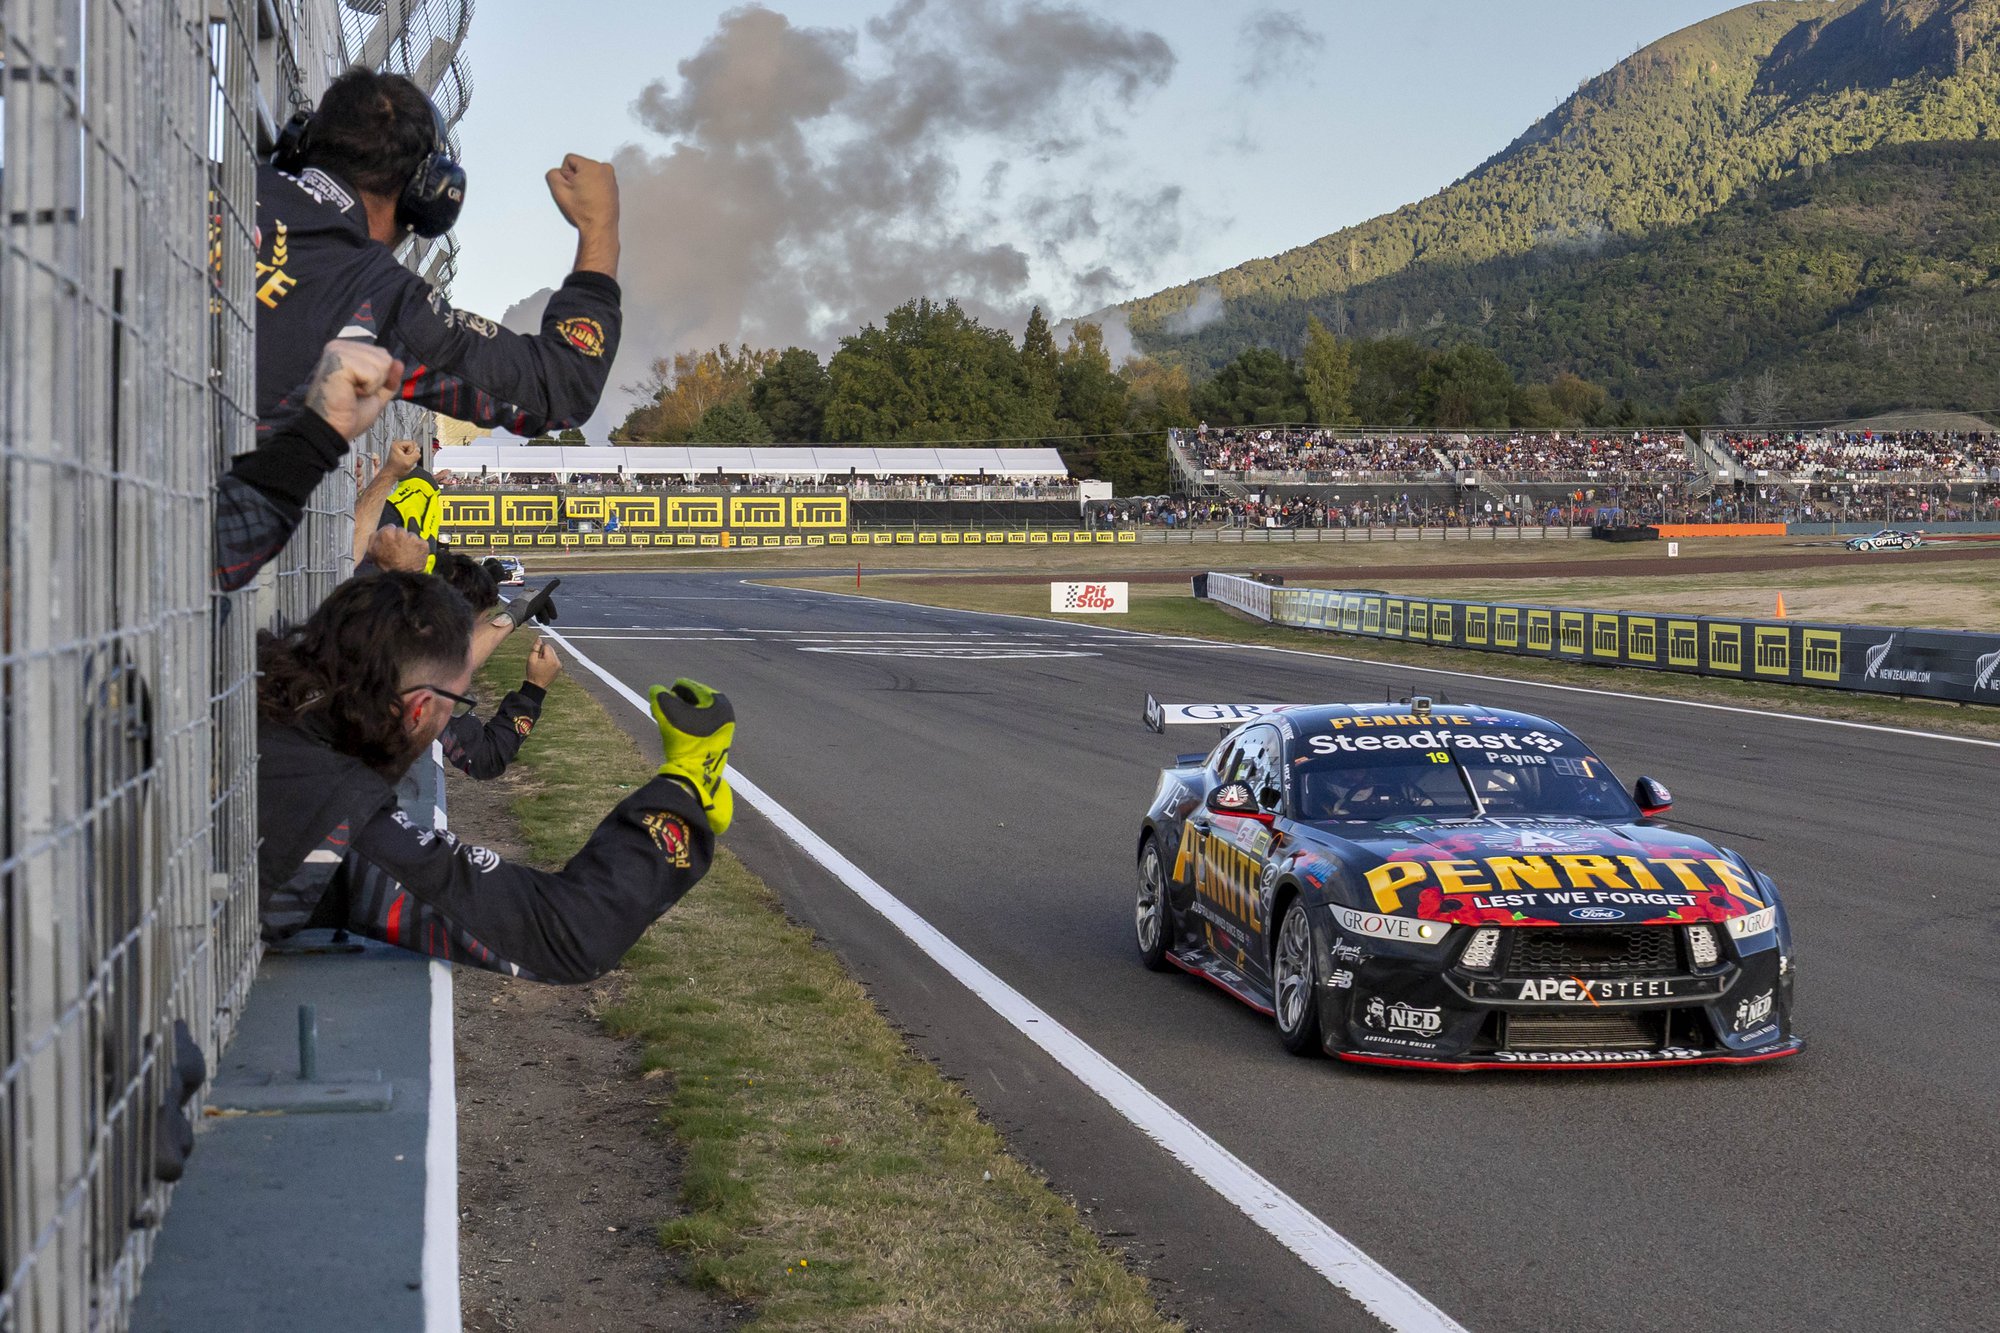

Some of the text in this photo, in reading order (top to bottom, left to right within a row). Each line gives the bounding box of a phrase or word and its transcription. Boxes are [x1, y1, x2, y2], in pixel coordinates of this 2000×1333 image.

[1875, 538, 1903, 546] OPTUS
[1084, 585, 1106, 598] Pit
[1076, 595, 1114, 610] Stop
[1330, 713, 1472, 729] PENRITE
[1309, 730, 1521, 754] Steadfast
[1426, 752, 1450, 763] 19
[1485, 752, 1546, 766] Payne
[1363, 855, 1765, 914] PENRITE
[1473, 891, 1697, 909] LEST WE FORGET
[1579, 908, 1615, 919] Ford
[1343, 911, 1410, 937] GROVE
[1518, 977, 1674, 1004] APEX STEEL
[1748, 996, 1773, 1022] NED
[1390, 1008, 1442, 1030] NED
[1364, 1035, 1437, 1049] AUSTRALIAN WHISKY
[1494, 1049, 1655, 1062] Steadfast
